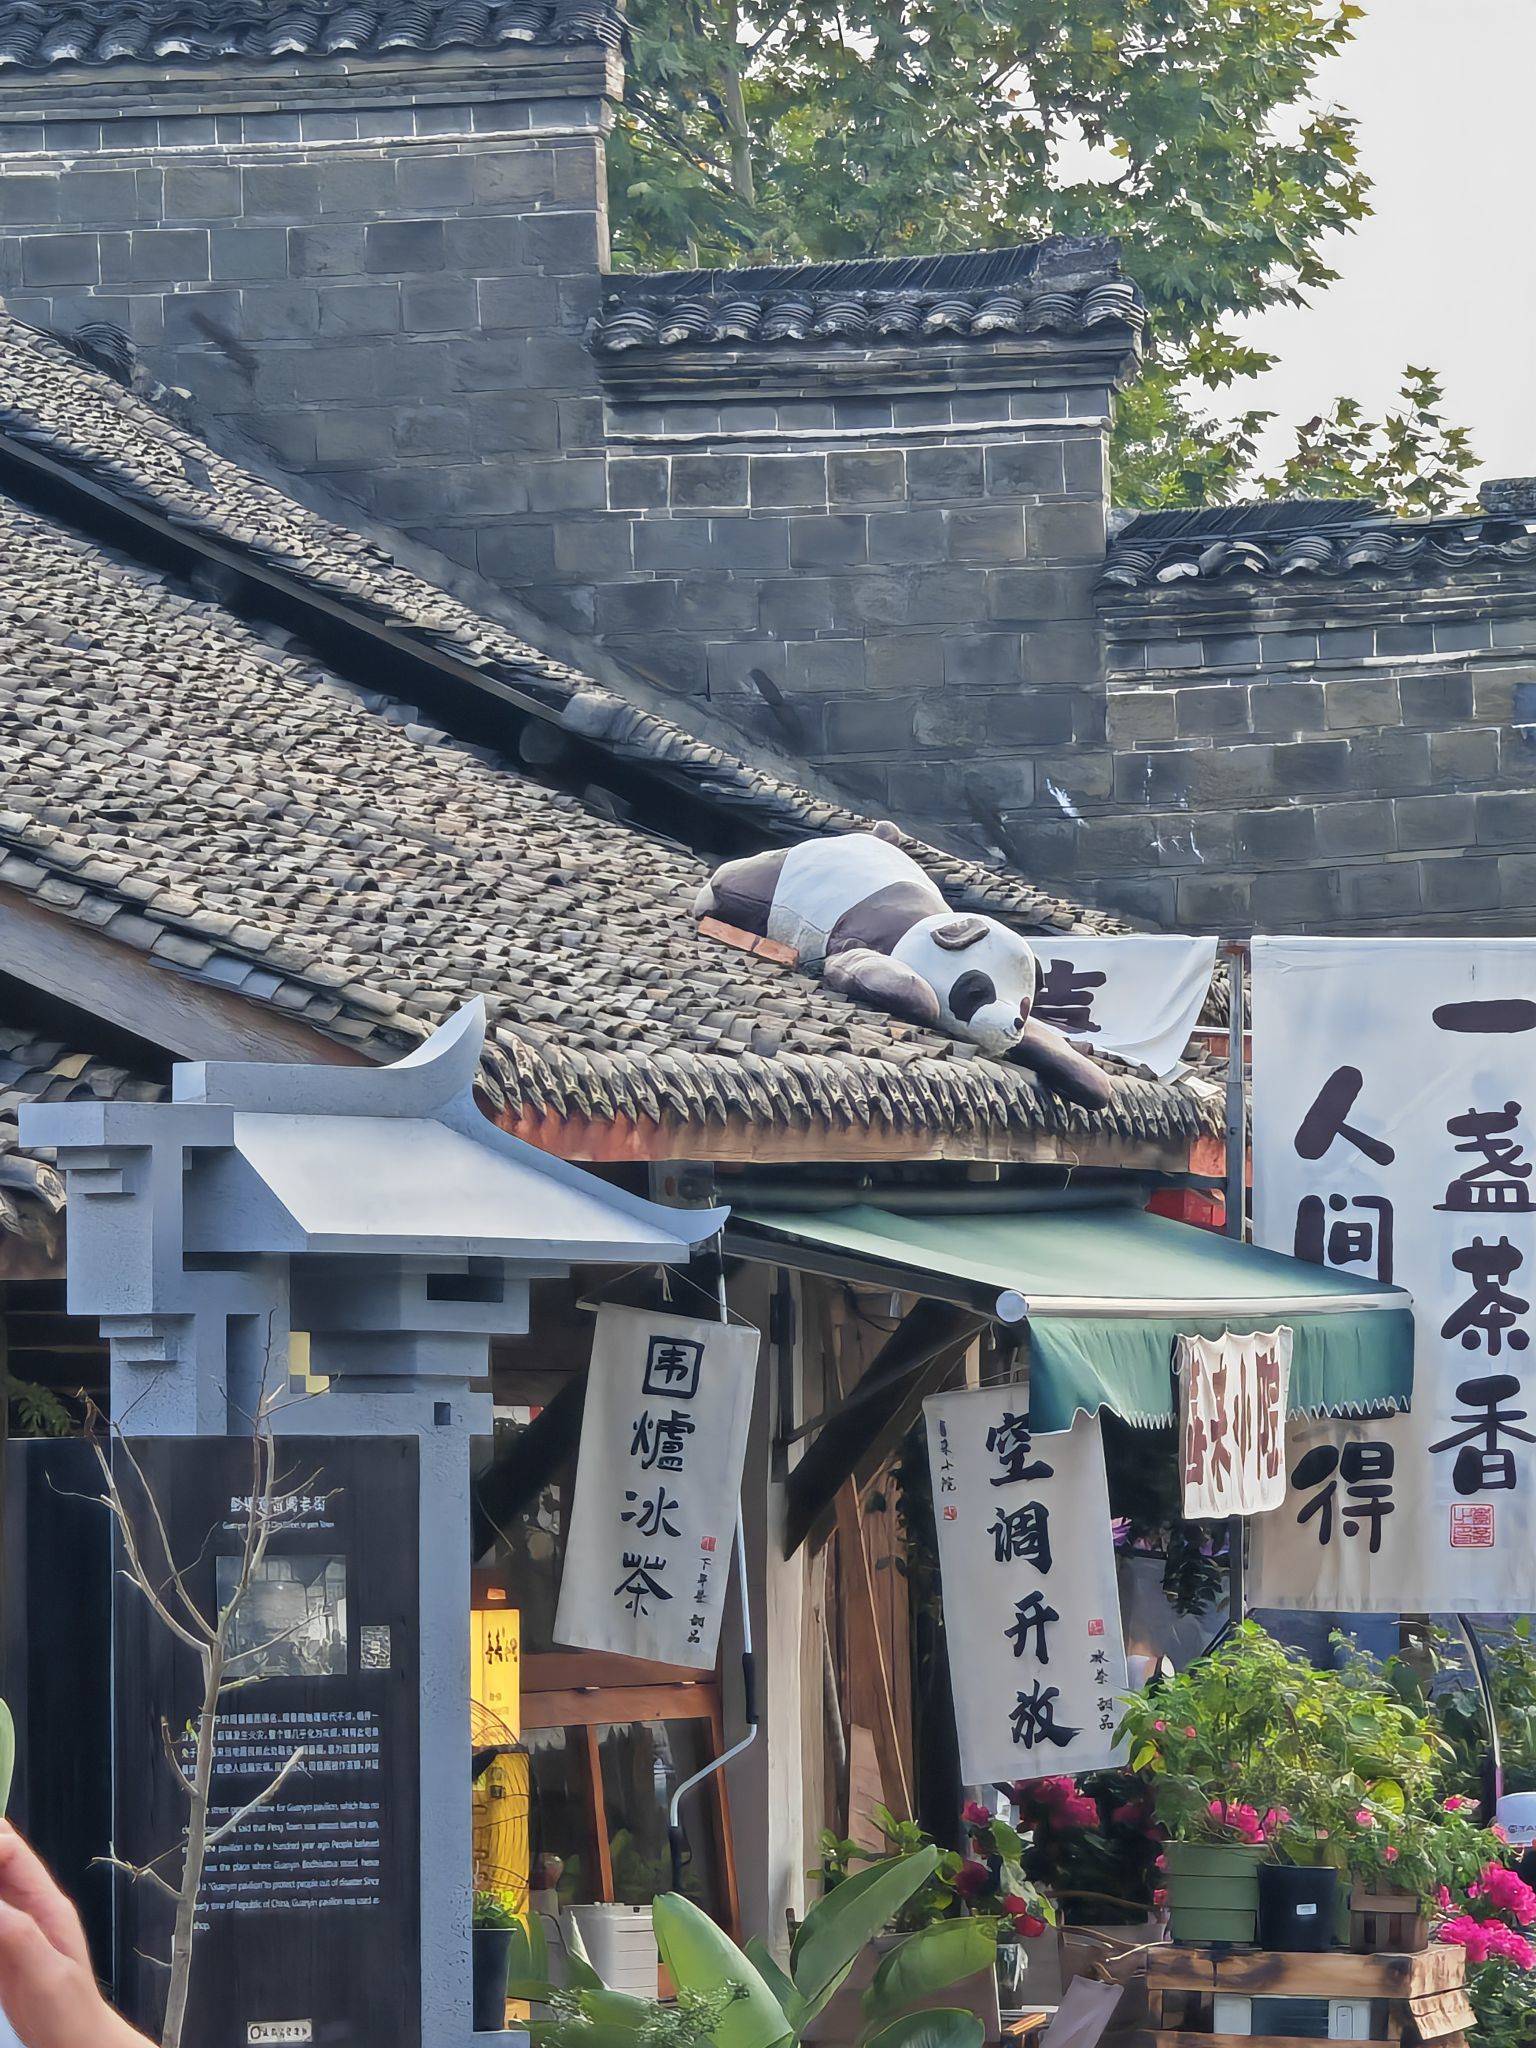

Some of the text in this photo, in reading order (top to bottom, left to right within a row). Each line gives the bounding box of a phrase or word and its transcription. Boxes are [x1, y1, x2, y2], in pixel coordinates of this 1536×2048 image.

[1291, 1065, 1396, 1553] 人间得
[1428, 998, 1536, 1496] 一盏茶香
[986, 1412, 1084, 1749] 空调开放
